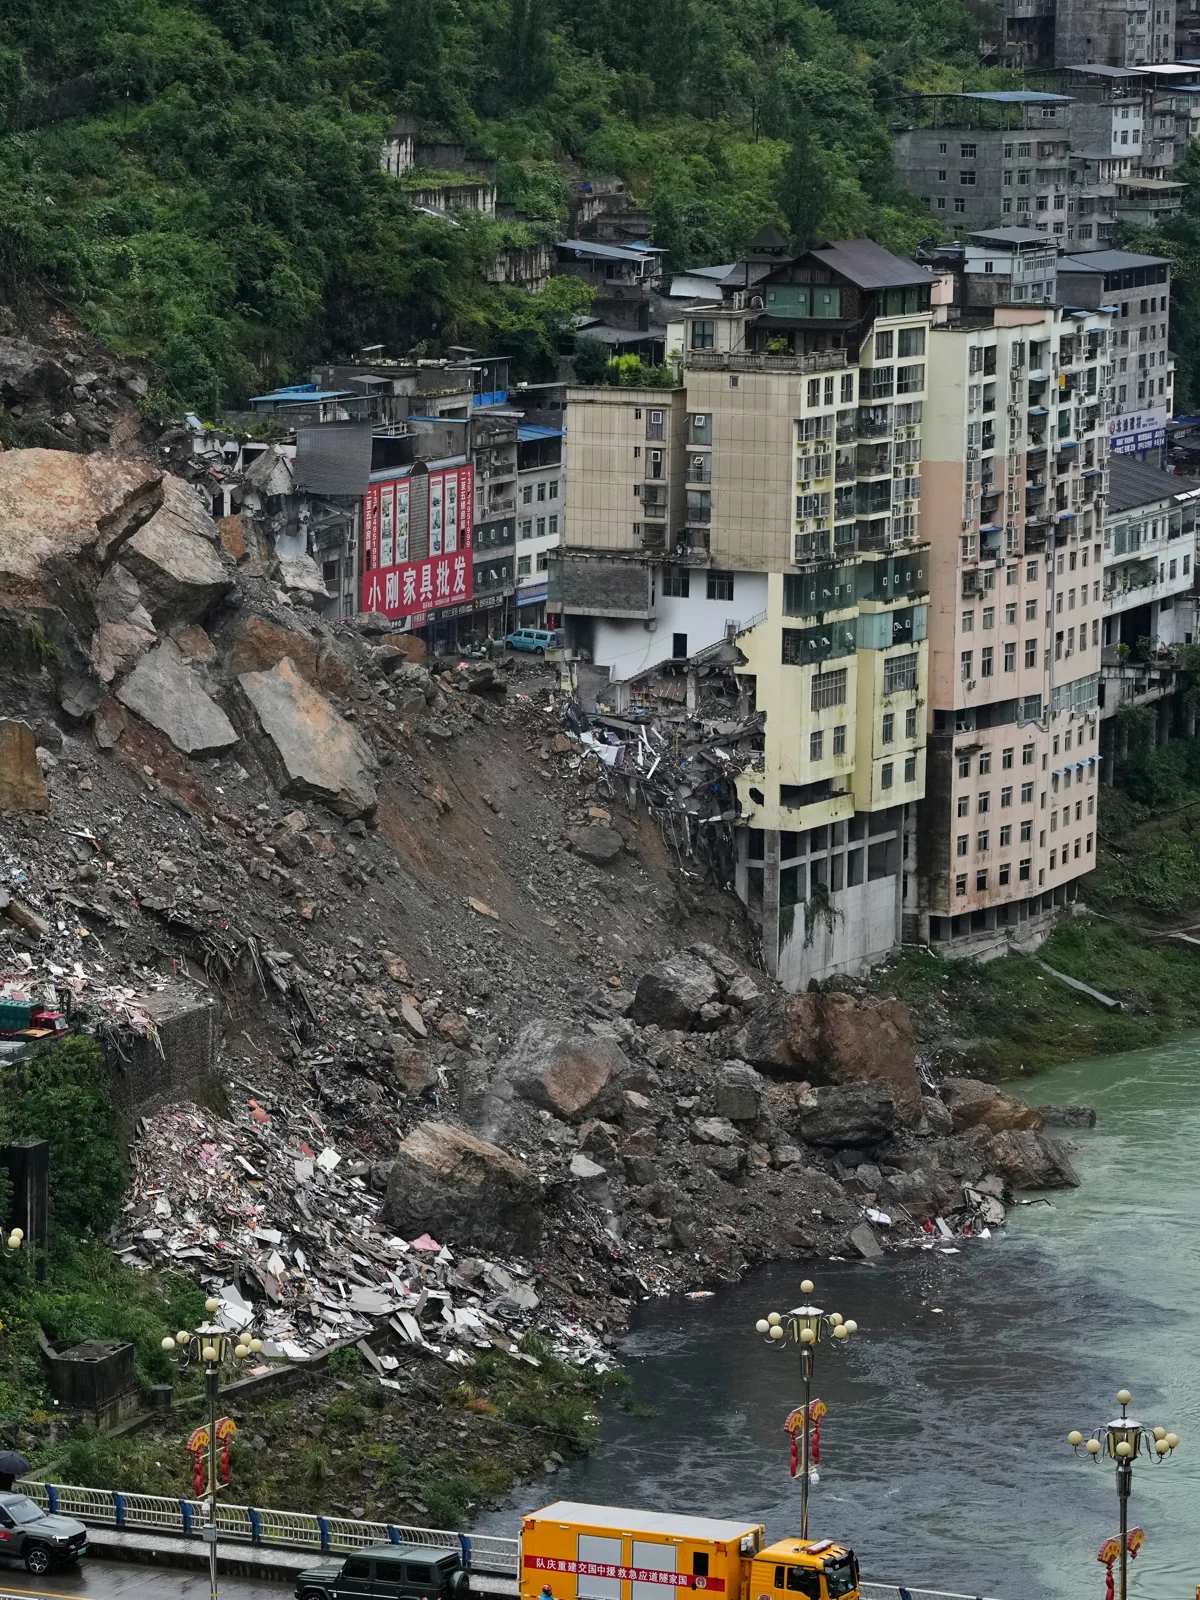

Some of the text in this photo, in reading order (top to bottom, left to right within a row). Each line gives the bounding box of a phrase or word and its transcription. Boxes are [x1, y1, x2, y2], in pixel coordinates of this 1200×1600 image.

[368, 556, 465, 611] 小刚家具批发
